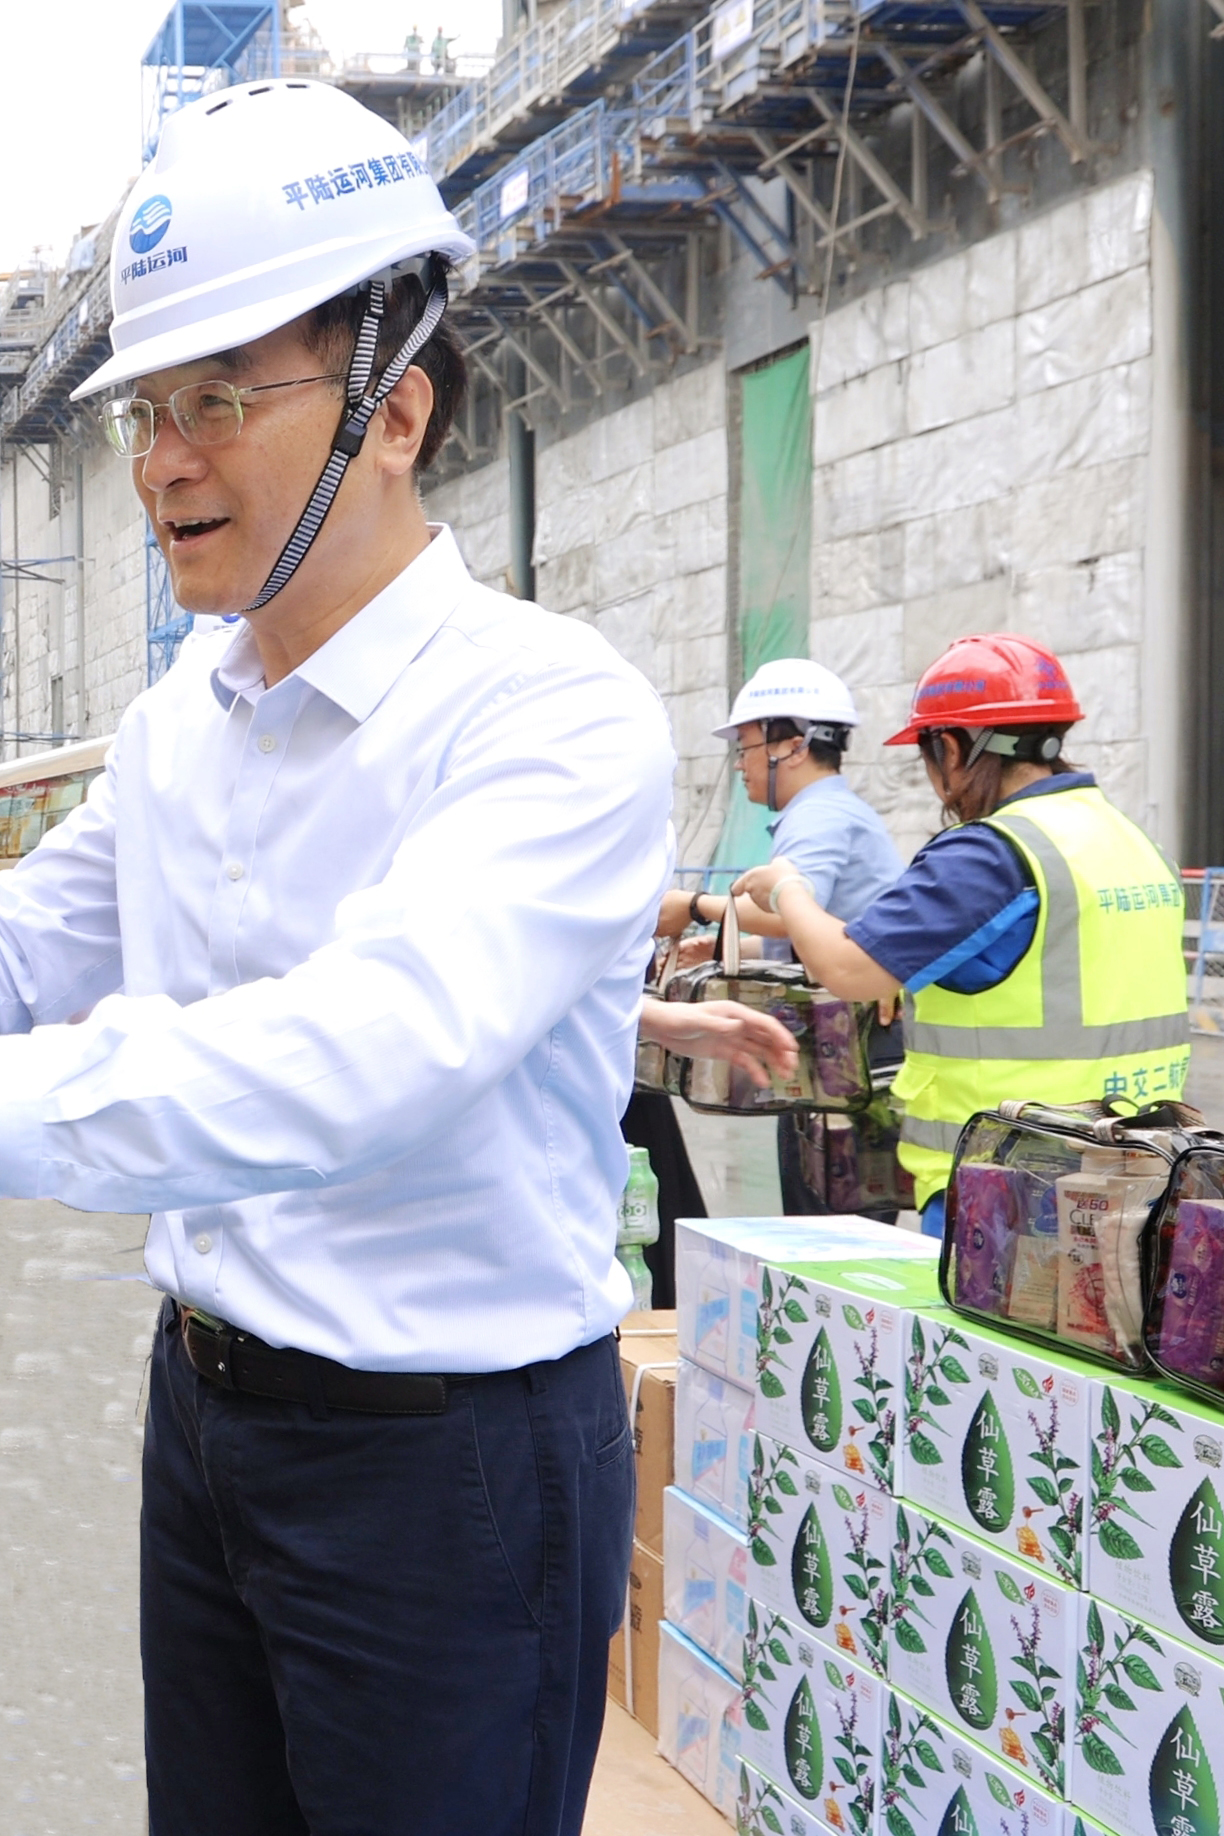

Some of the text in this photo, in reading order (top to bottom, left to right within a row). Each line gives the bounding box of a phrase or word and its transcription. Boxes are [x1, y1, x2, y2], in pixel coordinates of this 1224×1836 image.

[121, 246, 188, 285] 平陆运河
[1097, 882, 1181, 914] 平陆运河集团
[811, 1344, 832, 1441] 仙草露
[976, 1410, 1000, 1520] 仙草露
[802, 1519, 822, 1617] 仙草露
[1190, 1500, 1223, 1628] 仙草露
[959, 1606, 983, 1717] 仙草露
[793, 1691, 814, 1788] 仙草露
